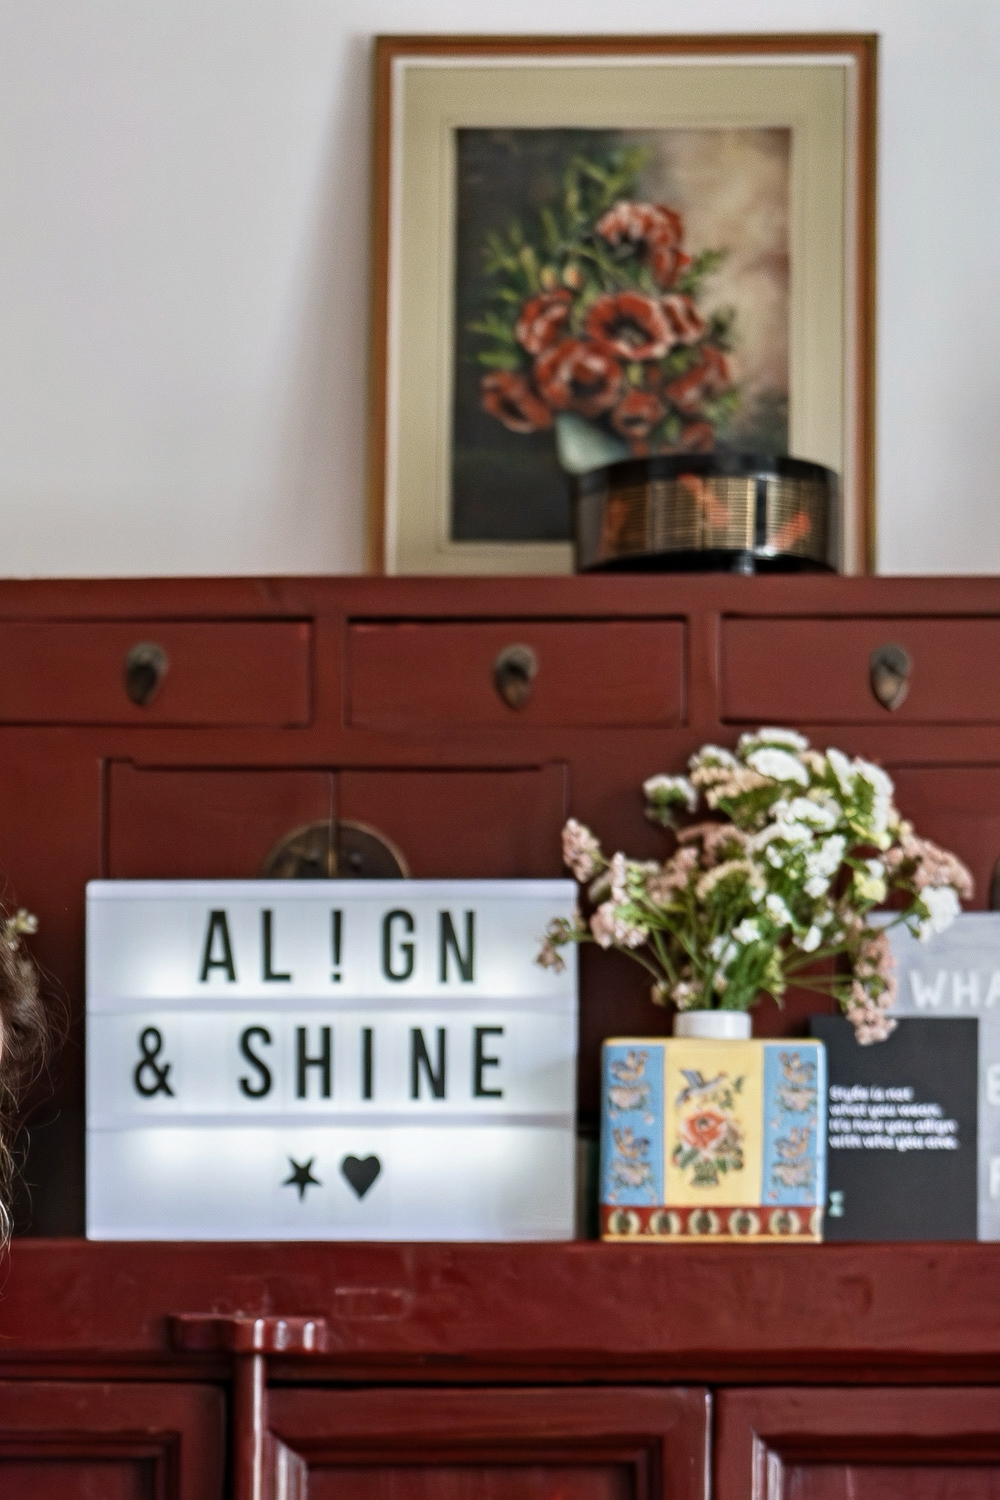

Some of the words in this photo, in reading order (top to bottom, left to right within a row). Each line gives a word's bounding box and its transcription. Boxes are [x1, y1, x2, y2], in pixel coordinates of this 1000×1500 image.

[199, 909, 476, 983] AL!GN
[133, 1026, 175, 1098] &
[238, 1026, 505, 1100] SHINE
[886, 1086, 914, 1101] not
[868, 1104, 897, 1120] you
[885, 1120, 914, 1136] you
[895, 1136, 924, 1152] you
